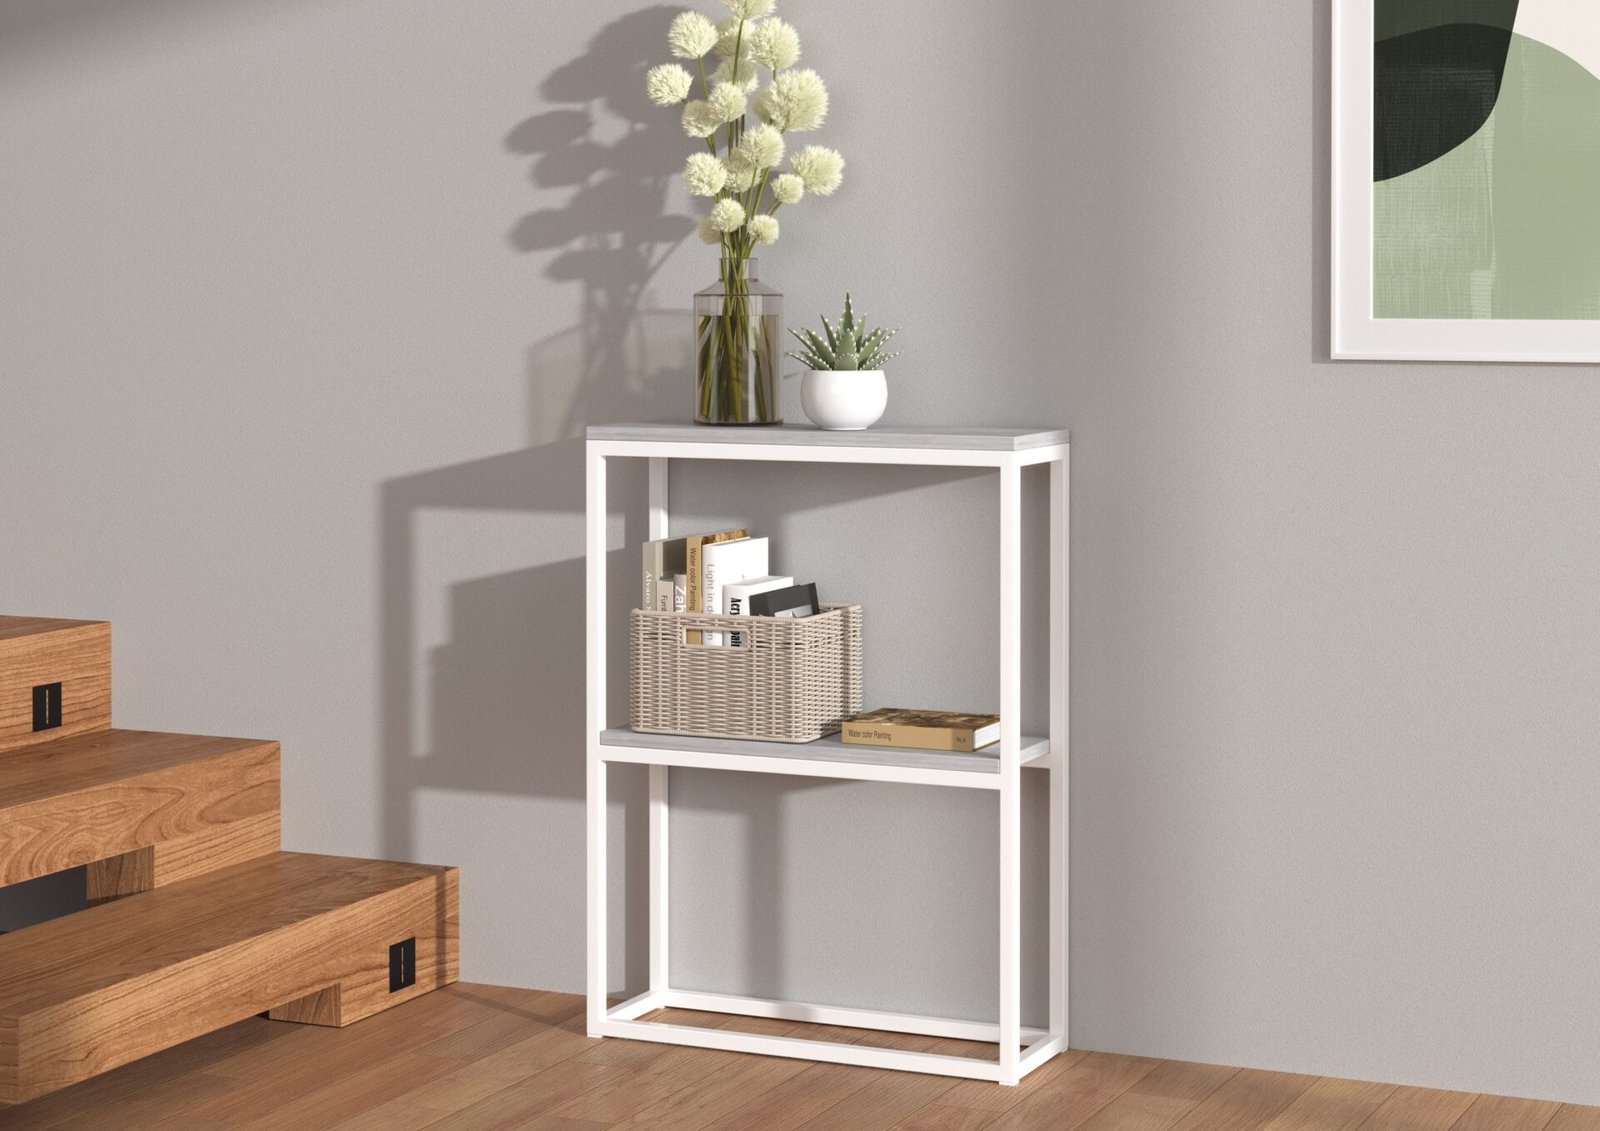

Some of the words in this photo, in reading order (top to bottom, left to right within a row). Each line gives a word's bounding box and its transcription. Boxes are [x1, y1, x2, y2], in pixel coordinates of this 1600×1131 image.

[705, 563, 716, 590] Light
[674, 585, 687, 613] Zah
[689, 585, 697, 611] Painting
[848, 729, 862, 738] Water
[862, 731, 874, 739] color
[874, 730, 892, 742] Painting
